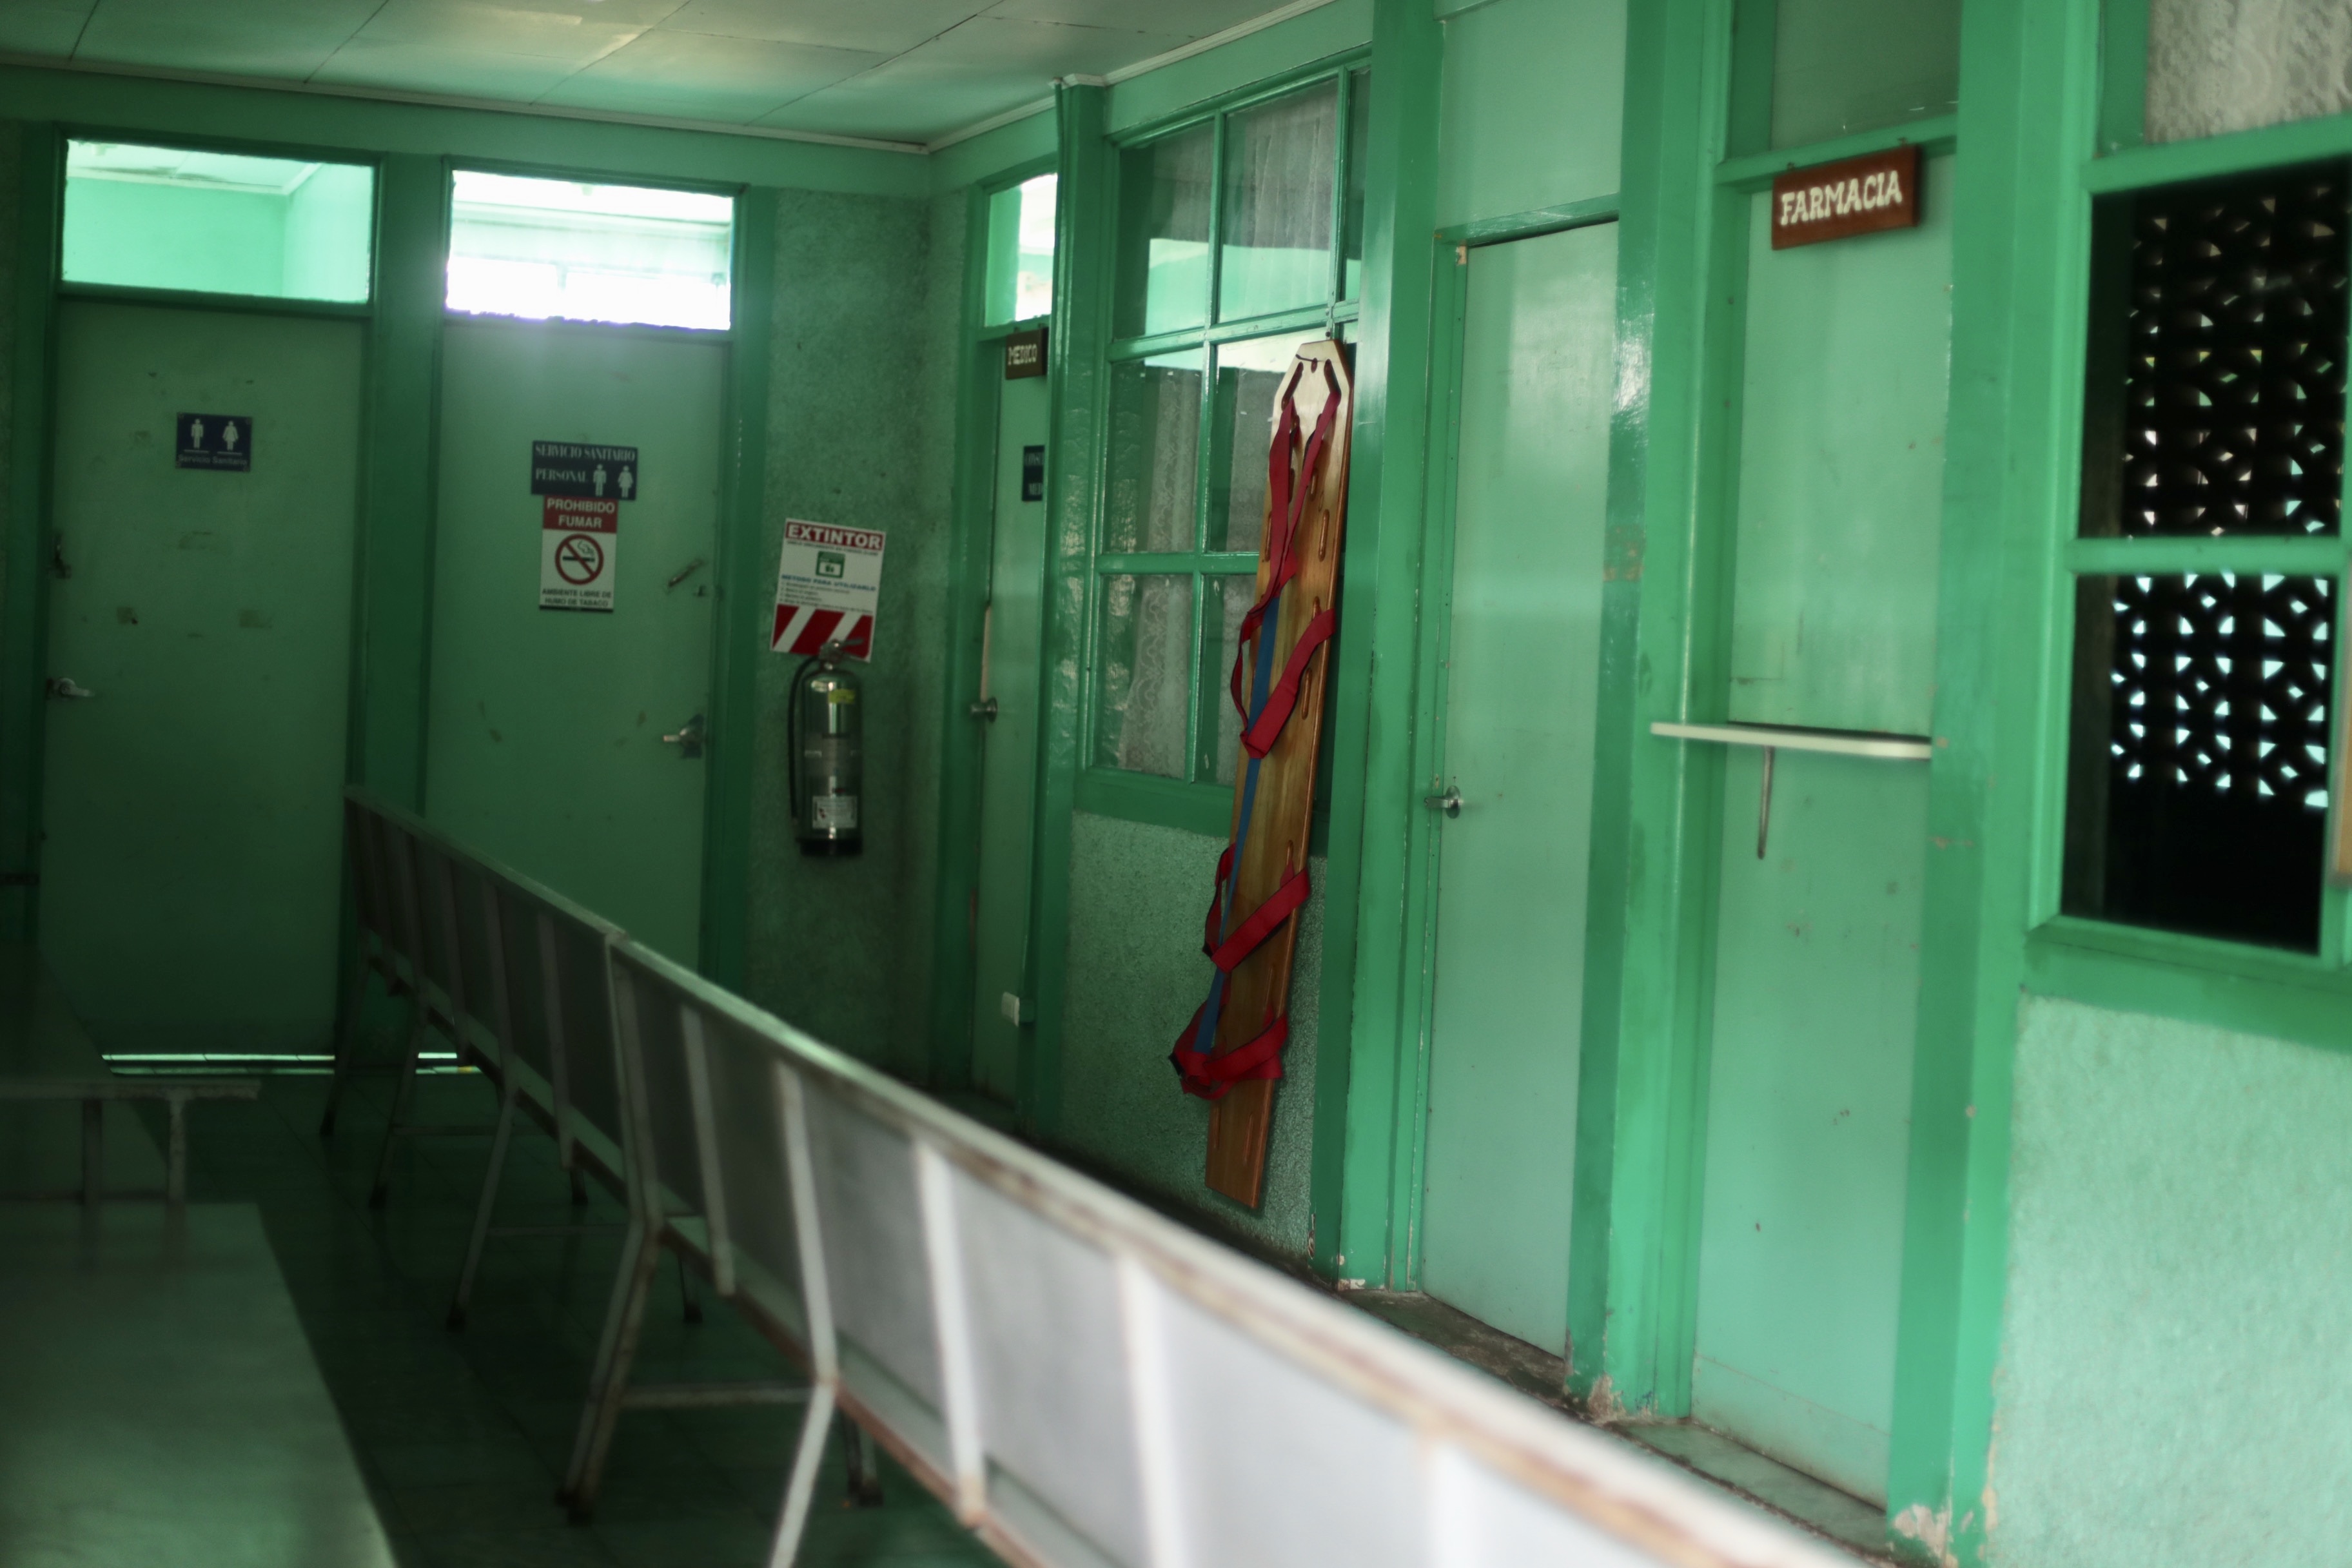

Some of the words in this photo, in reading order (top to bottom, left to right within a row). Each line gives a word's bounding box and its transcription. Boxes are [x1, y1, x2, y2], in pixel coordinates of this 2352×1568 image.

[1781, 170, 1903, 226] FARMACIA
[535, 443, 582, 458] SERVICIO
[584, 446, 636, 462] SANITARIO
[535, 467, 587, 483] PERSONAL
[547, 498, 615, 514] PROHIBIDO
[558, 515, 603, 528] FUMAR
[788, 524, 881, 549] EXTINTOR
[542, 588, 578, 597] AMBIENTE
[580, 589, 600, 598] LIBRE
